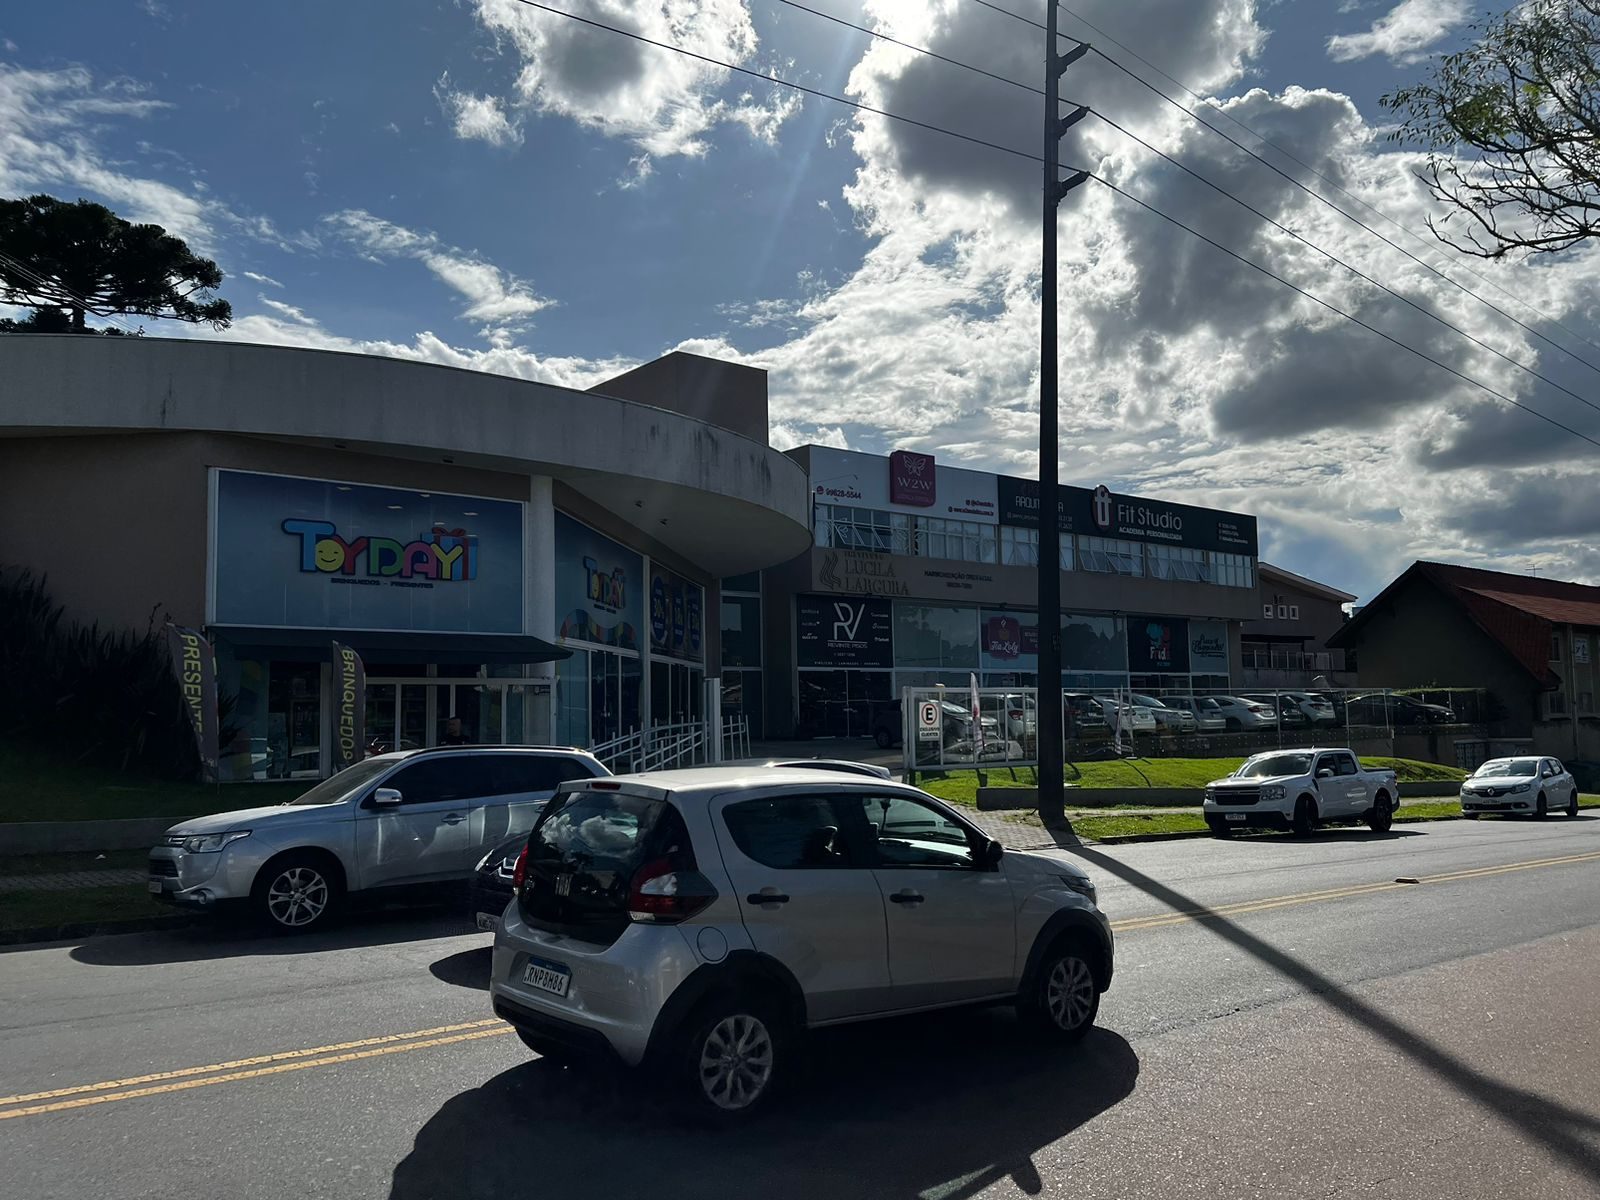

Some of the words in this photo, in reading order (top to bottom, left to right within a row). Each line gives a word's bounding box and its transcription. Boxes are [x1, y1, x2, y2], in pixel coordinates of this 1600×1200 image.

[897, 476, 933, 491] W2W
[1117, 503, 1135, 524] Fit
[1137, 506, 1183, 531] Studio
[281, 518, 464, 580] TOYDAY
[331, 577, 380, 586] BRINQUEDOS
[390, 580, 434, 589] PRESENTES
[926, 708, 933, 720] E
